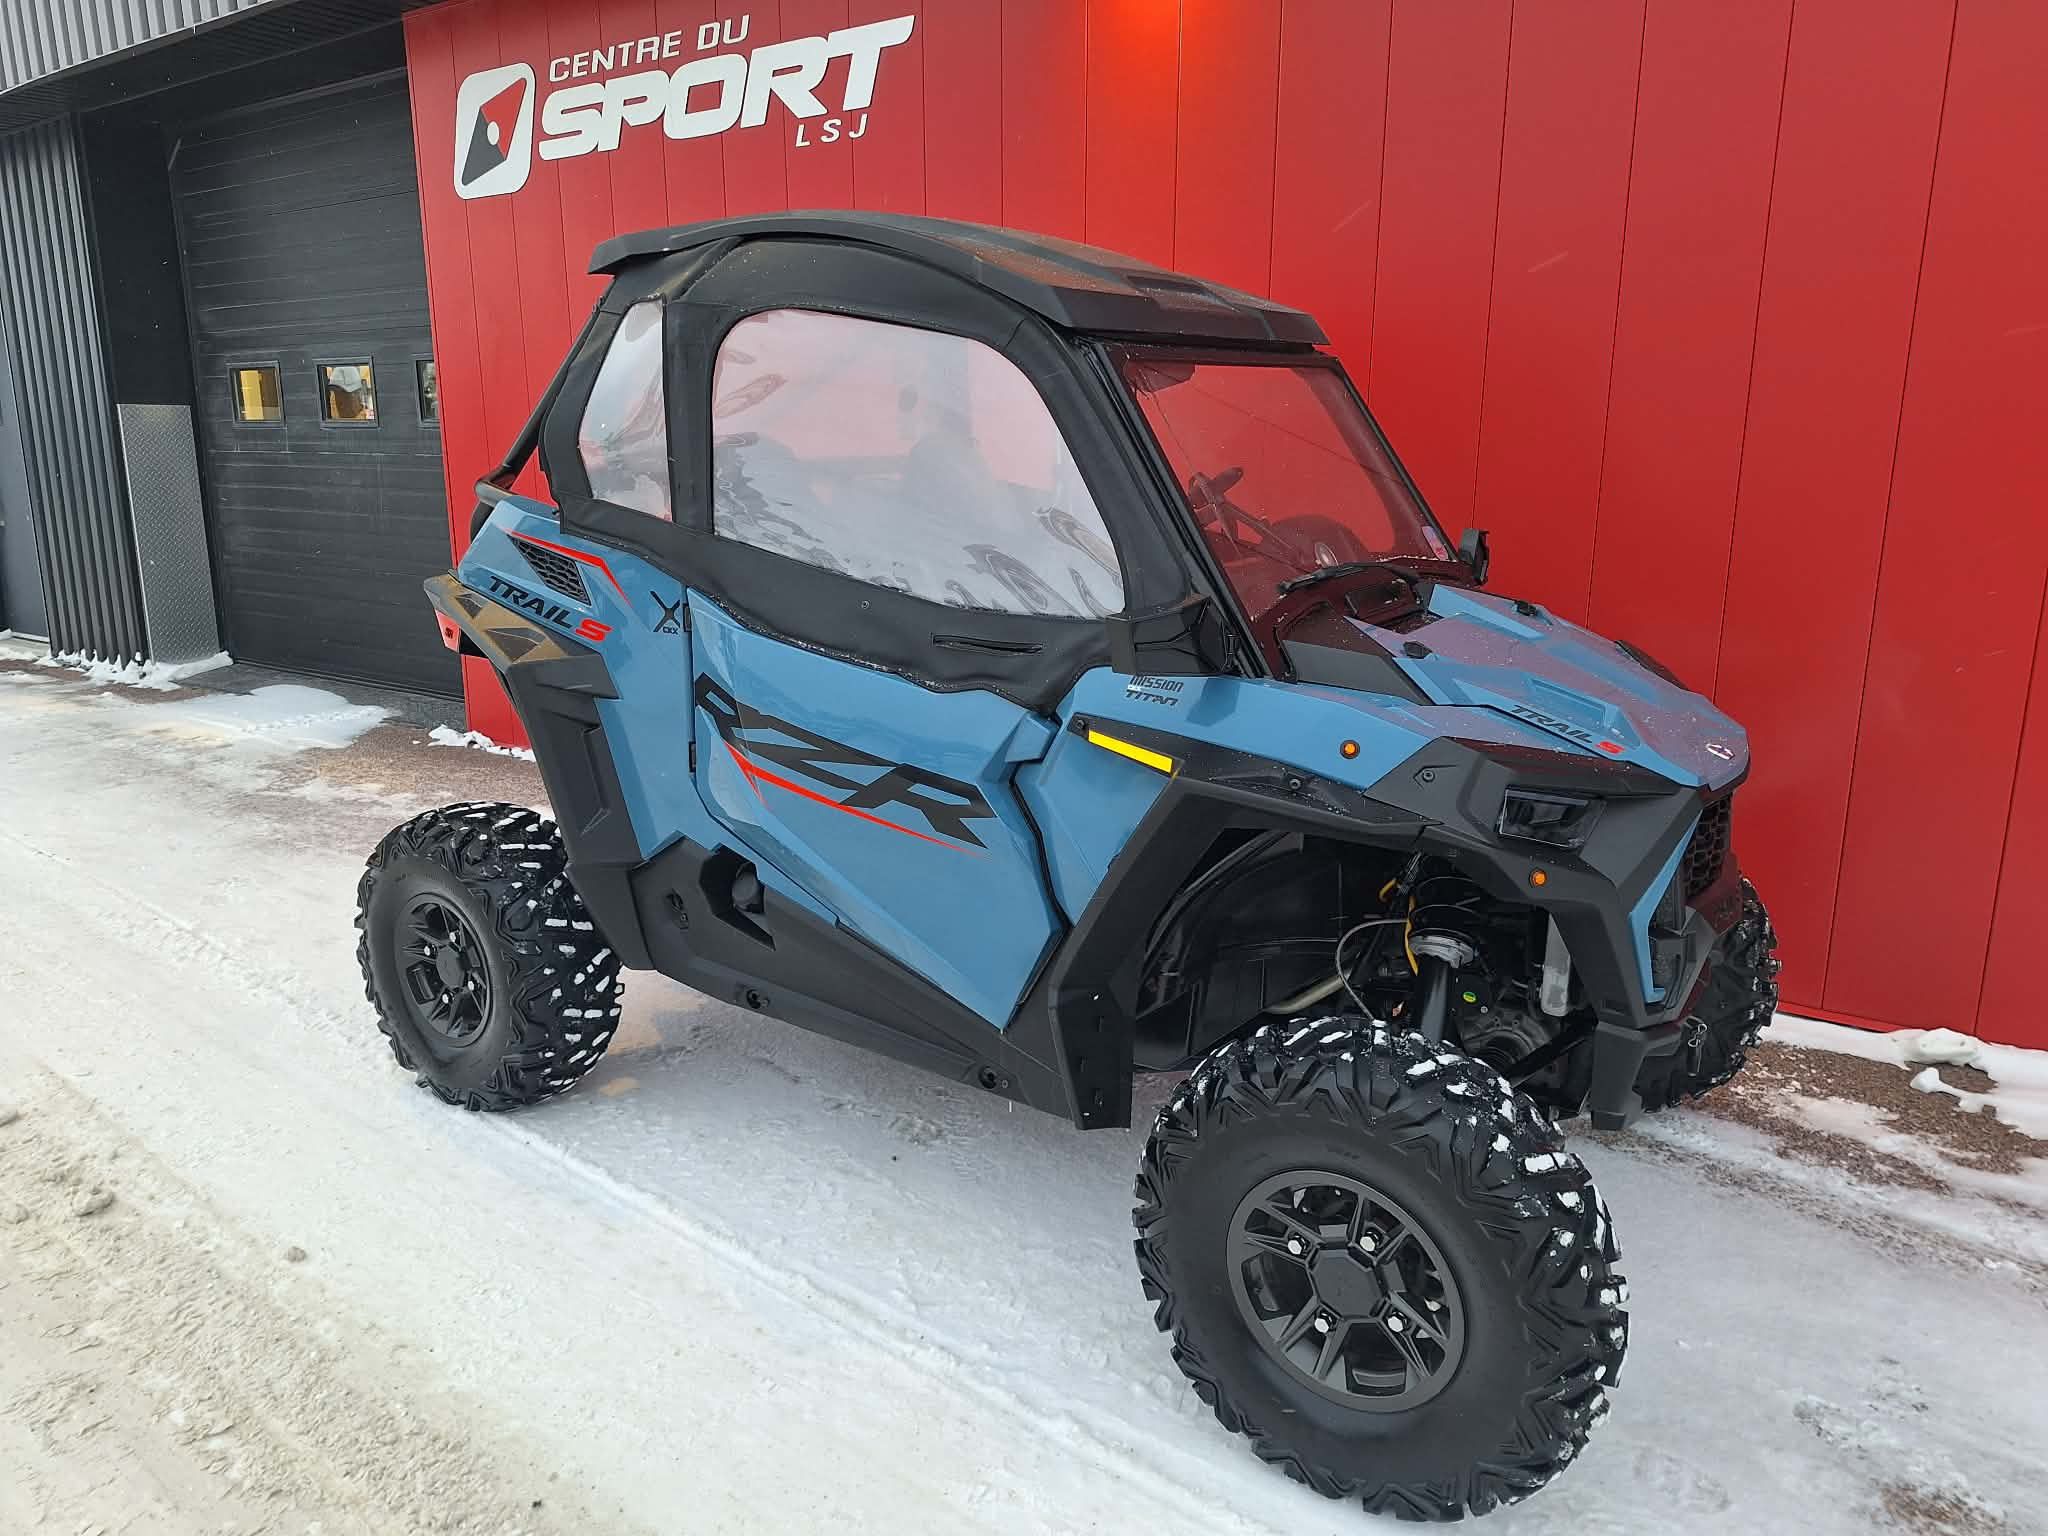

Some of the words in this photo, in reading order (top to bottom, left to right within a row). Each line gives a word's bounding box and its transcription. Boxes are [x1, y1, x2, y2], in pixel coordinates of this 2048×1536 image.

[549, 30, 682, 82] CENTRE
[697, 14, 750, 51] DU
[538, 15, 916, 160] SPORT
[489, 576, 573, 629] TRAIL
[575, 618, 613, 642] S
[1126, 689, 1178, 706] TITAN
[1129, 674, 1184, 693] MISSION
[1511, 704, 1593, 743] TRAIL
[695, 672, 998, 849] RZR
